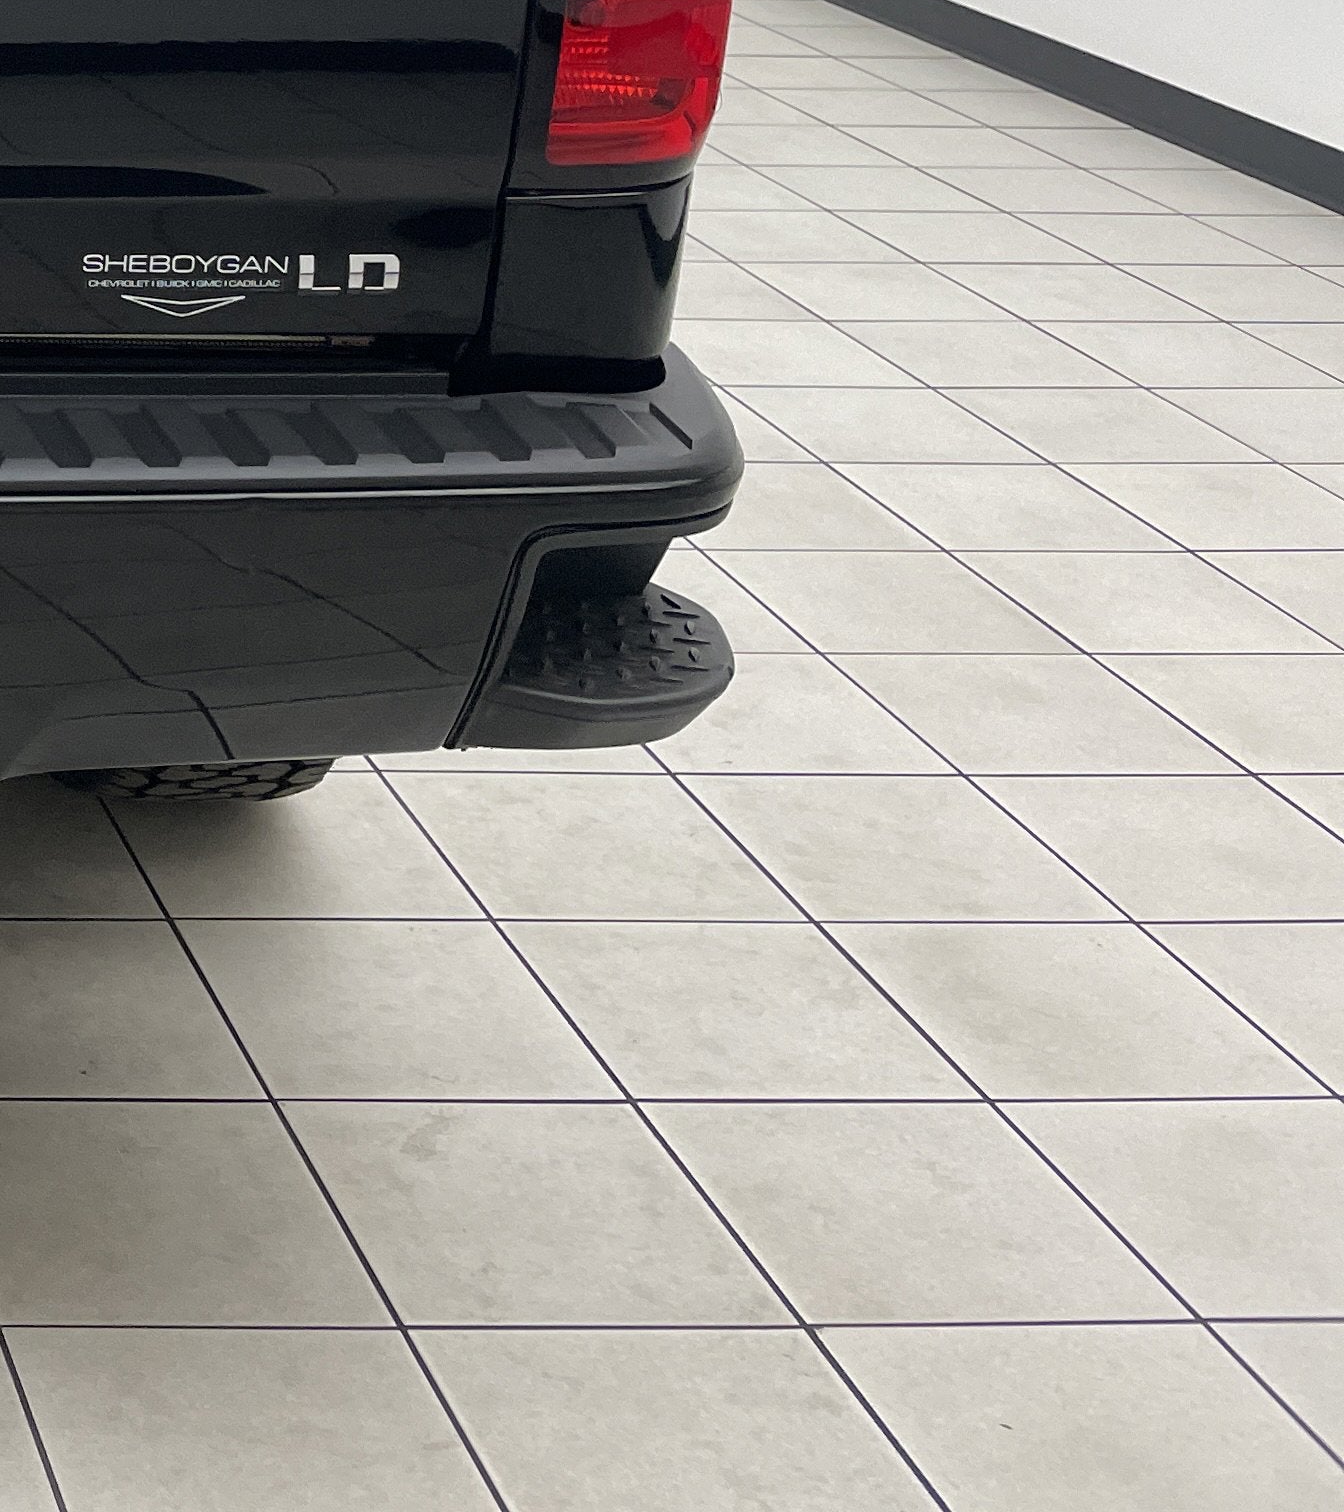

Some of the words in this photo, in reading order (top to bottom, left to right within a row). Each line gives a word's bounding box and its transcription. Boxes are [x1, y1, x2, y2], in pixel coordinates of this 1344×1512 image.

[82, 253, 289, 274] SHEBOYGAN
[298, 253, 401, 292] LD
[87, 279, 150, 288] CHEVROLET
[156, 279, 188, 288] BUICK
[195, 279, 222, 288] GMC
[228, 279, 281, 288] CADILLAC
